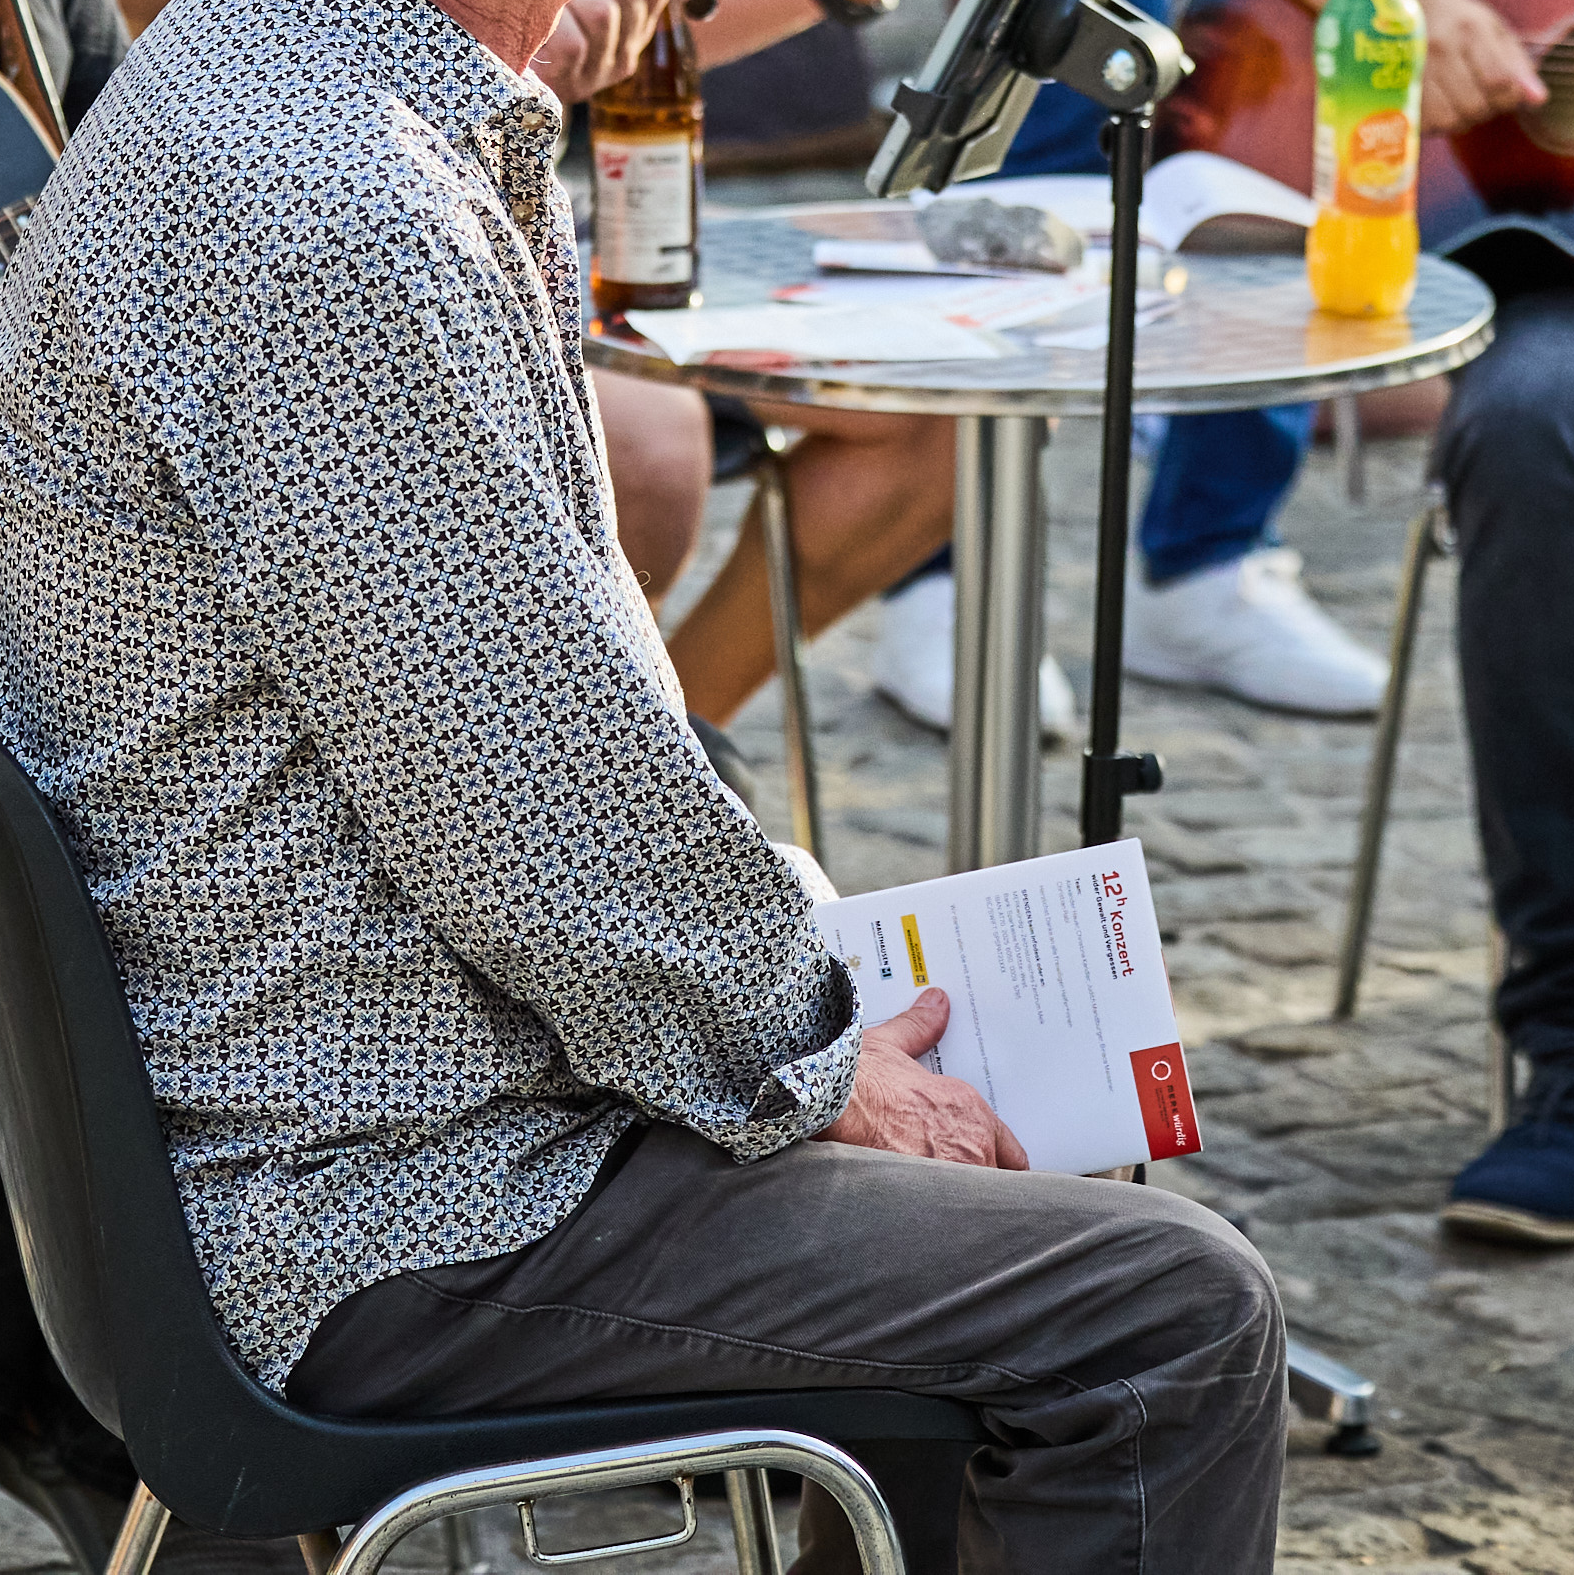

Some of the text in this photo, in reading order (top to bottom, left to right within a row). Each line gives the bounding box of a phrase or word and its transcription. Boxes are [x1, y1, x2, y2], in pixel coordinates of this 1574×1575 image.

[1020, 889, 1032, 919] SPENDEN
[1027, 919, 1035, 934] beim
[1090, 873, 1119, 979] wider Gewalt und Vergessen
[874, 920, 889, 965] MAUTHAUSEN
[1030, 935, 1041, 961] Infodesk
[1109, 910, 1134, 977] Konzert
[1036, 962, 1044, 977] oder
